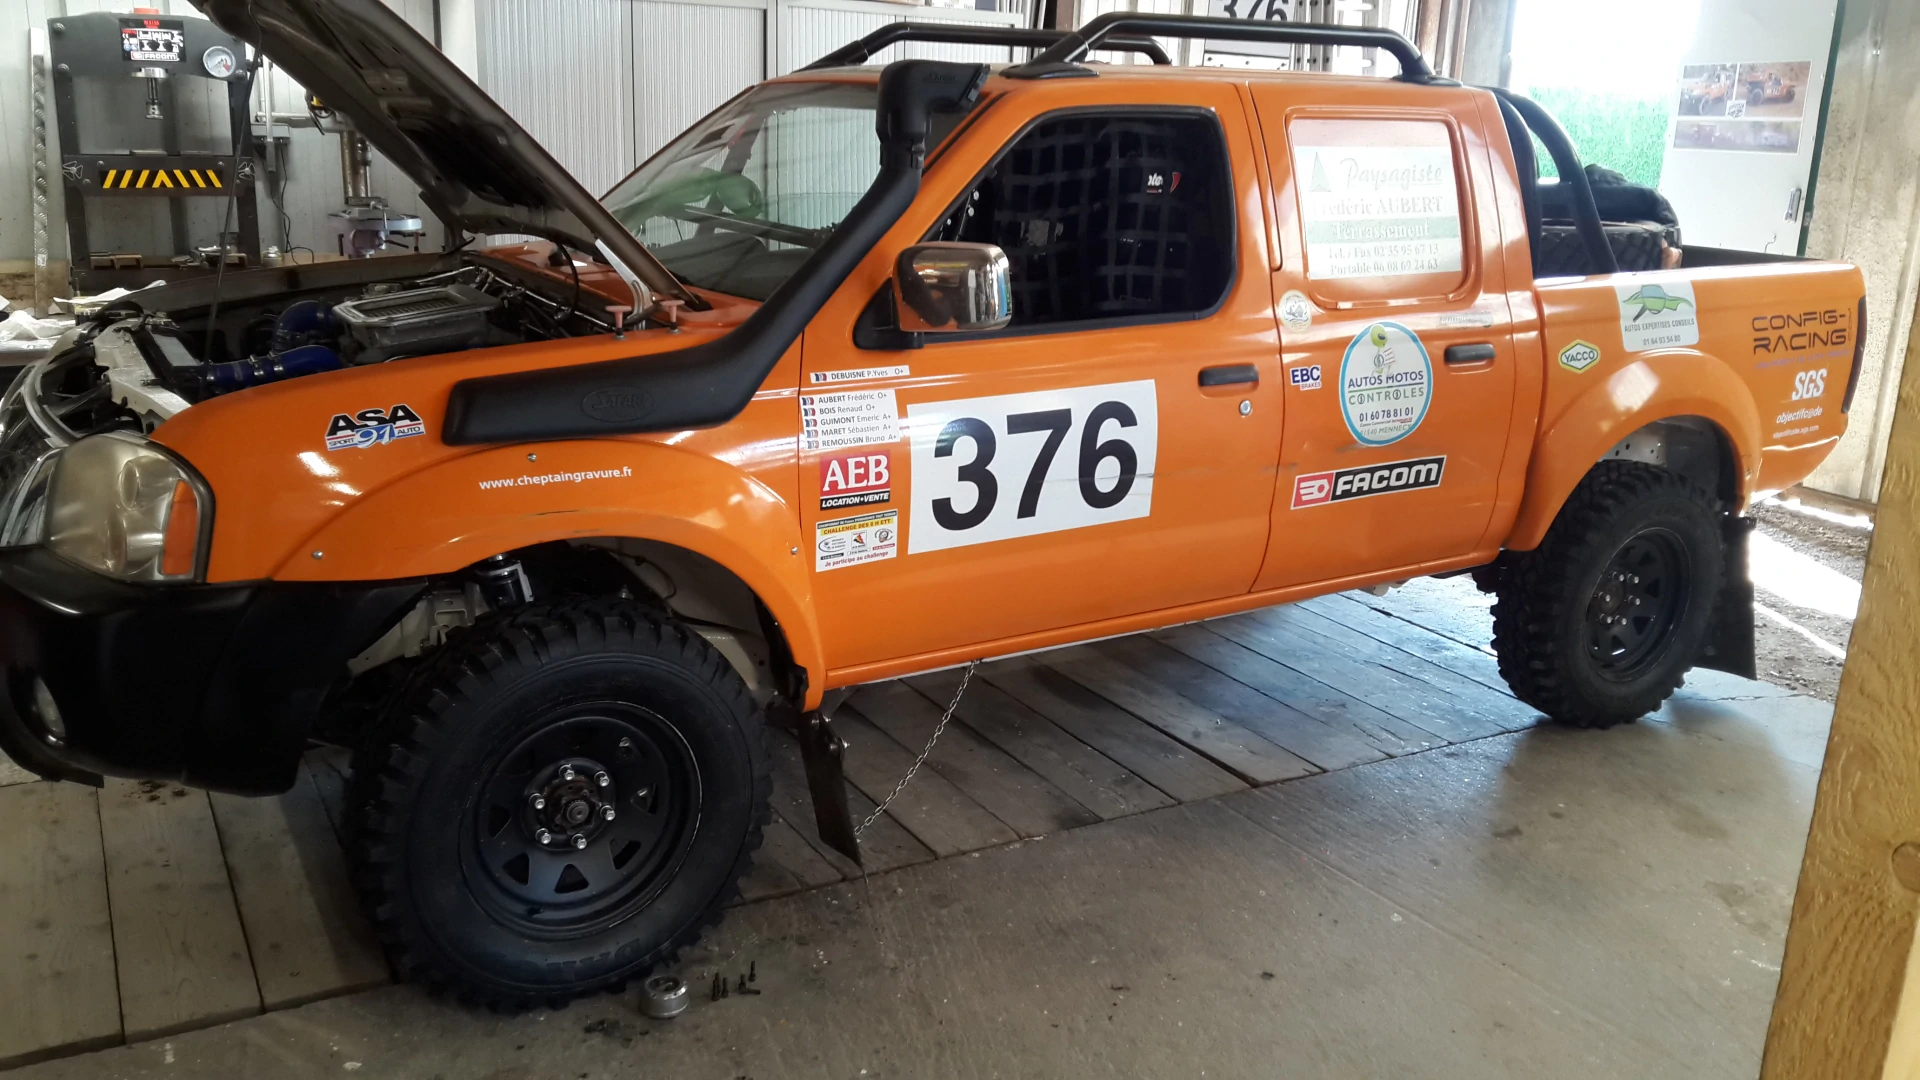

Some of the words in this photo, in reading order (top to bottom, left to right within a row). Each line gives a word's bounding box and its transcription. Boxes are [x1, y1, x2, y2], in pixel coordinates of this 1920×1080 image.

[1340, 158, 1442, 191] Paysagiste
[1376, 196, 1443, 214] AUBERT
[1333, 220, 1430, 240] Terrassement
[1354, 246, 1372, 259] Fax
[1374, 246, 1385, 258] 02
[1388, 246, 1398, 257] 35
[1401, 244, 1412, 256] 95
[1414, 244, 1426, 256] 67
[1429, 243, 1439, 254] 13
[1330, 262, 1374, 276] Portable
[1374, 262, 1384, 272] 06
[1388, 261, 1398, 272] 08
[1400, 260, 1412, 271] 69
[1414, 260, 1426, 270] 24
[1428, 258, 1438, 270] 63
[1624, 324, 1640, 332] AUTOS
[1642, 320, 1671, 330] EXPERTISES
[1672, 318, 1695, 328] CONSEILS
[1752, 310, 1846, 332] CONFIG-
[1754, 328, 1846, 355] RACING
[1564, 350, 1595, 363] YACCO
[831, 370, 866, 380] DEBUISNE
[1291, 366, 1320, 384] EBC
[1348, 375, 1382, 388] AUTOS
[1386, 370, 1424, 384] MOTOS
[1792, 368, 1828, 400] SGS
[818, 395, 846, 404] AUBERT
[848, 392, 874, 402] Frédéric
[1348, 387, 1424, 405] CONTROLES
[820, 407, 836, 415] BOIS
[838, 405, 862, 413] Renaud
[1360, 412, 1368, 422] 01
[1370, 411, 1379, 420] 60
[1382, 410, 1391, 418] 78
[1393, 408, 1402, 418] 81
[1405, 406, 1413, 416] 01
[326, 404, 422, 437] ASA
[820, 416, 855, 426] GUIMONT
[857, 414, 880, 422] Emeric
[1379, 424, 1412, 434] MENNECY
[328, 438, 354, 446] SPORT
[356, 424, 392, 448] 91
[397, 427, 420, 435] AUTO
[822, 428, 846, 436] MARET
[848, 424, 880, 434] Sébastien
[822, 437, 864, 447] REMOUSSIN
[866, 435, 885, 443] Bruno
[822, 454, 890, 492] AEB
[932, 400, 1138, 530] 376
[479, 466, 632, 490] www.cheptaingravure.fr
[1336, 463, 1438, 496] FACOM
[823, 524, 858, 535] CHALLENGE
[832, 557, 855, 566] participe
[864, 551, 889, 560] challenge
